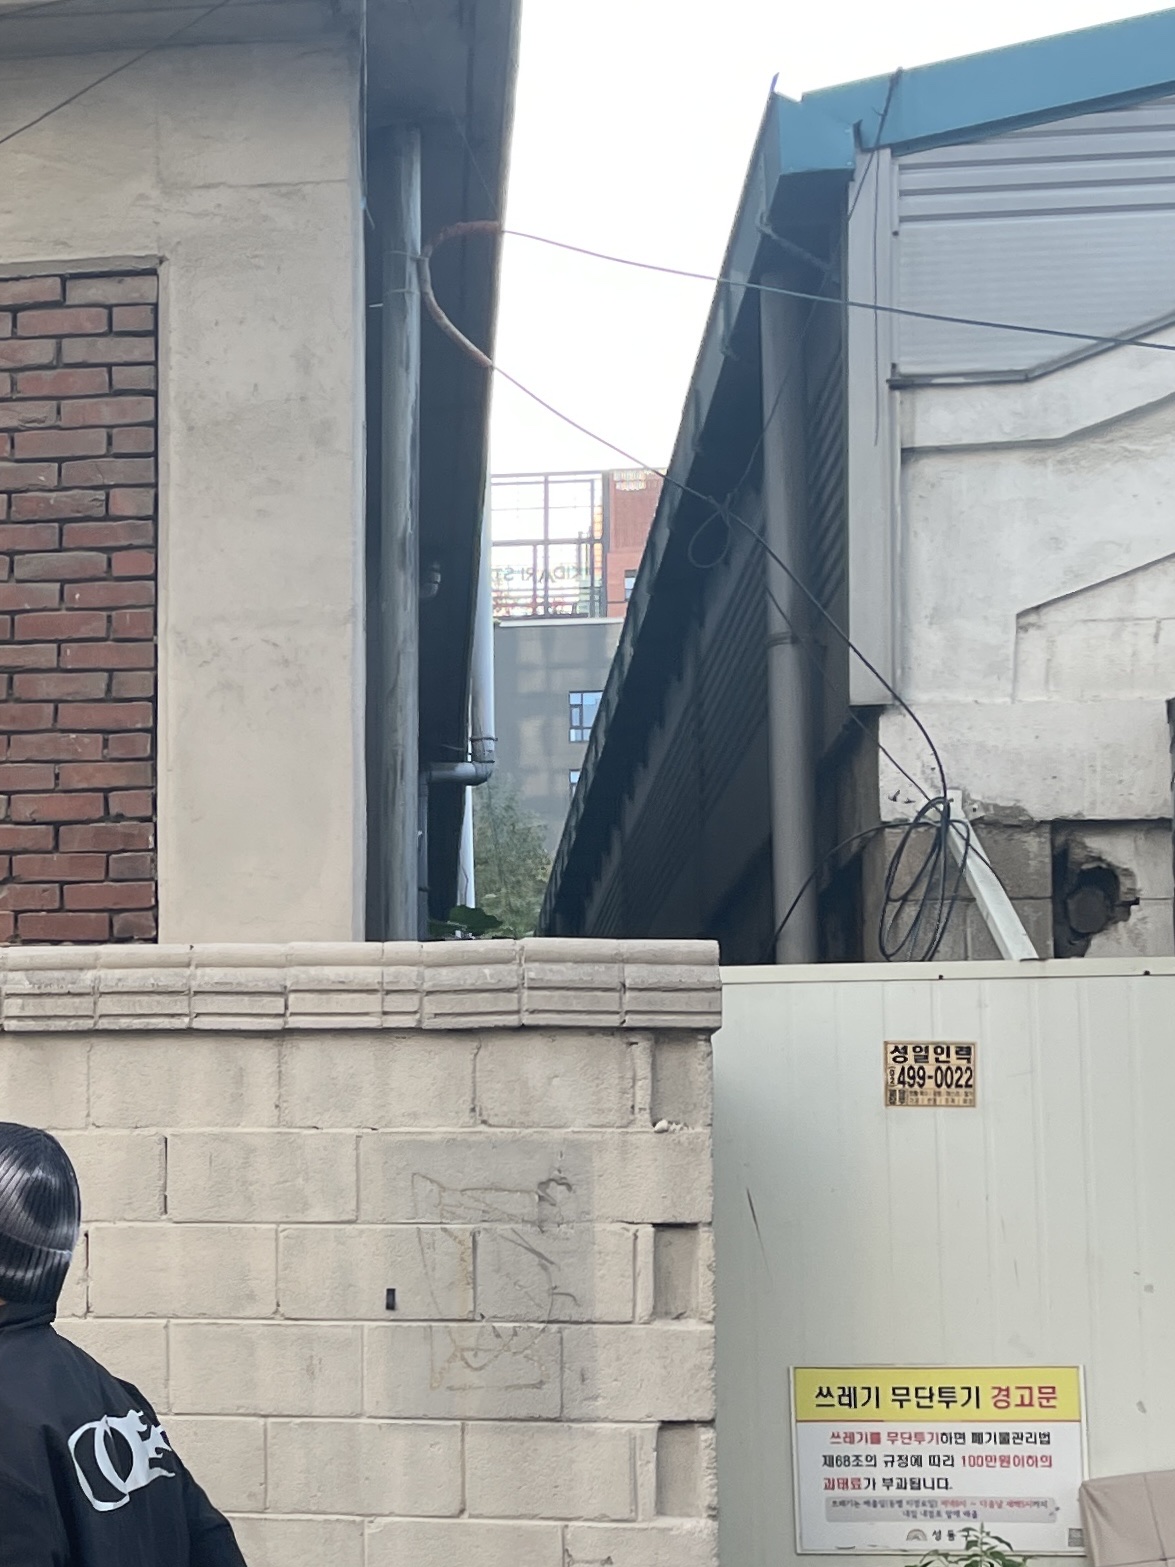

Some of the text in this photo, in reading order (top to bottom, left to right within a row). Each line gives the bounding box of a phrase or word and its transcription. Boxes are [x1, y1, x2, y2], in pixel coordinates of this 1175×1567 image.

[890, 1045, 972, 1064] 성일인력
[897, 1065, 973, 1088] 499-0022
[815, 1385, 1058, 1409] 쓰레기 무단투기 경고문
[830, 1431, 1052, 1446] 쓰레기를 무단투기하면 폐기물관리법
[822, 1454, 878, 1469] 제68조의
[883, 1454, 923, 1469] 규정에
[961, 1454, 1053, 1469] 100만원이하의
[823, 1477, 953, 1492] 과태료가 부과됩니다.
